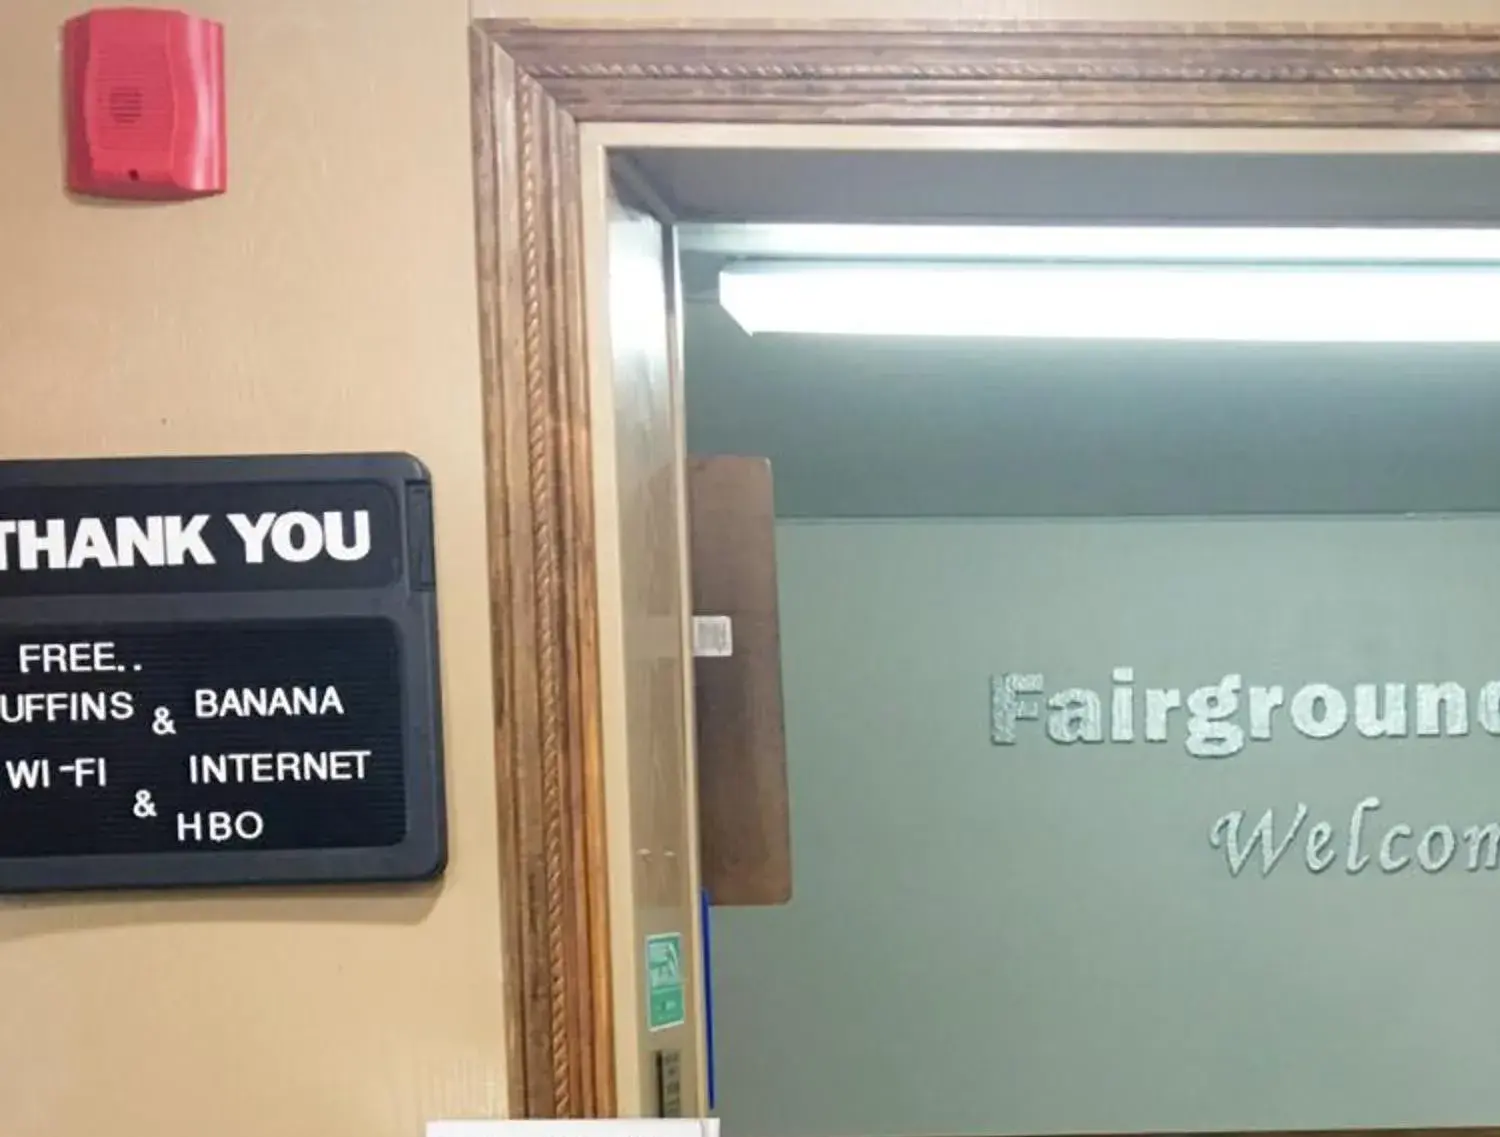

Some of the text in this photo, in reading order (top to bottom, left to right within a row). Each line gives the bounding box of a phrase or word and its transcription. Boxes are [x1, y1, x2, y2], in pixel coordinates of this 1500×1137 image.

[227, 510, 371, 564] YOU
[152, 707, 177, 735] &
[195, 686, 345, 719] BANANA
[189, 751, 372, 784] INTERNET
[133, 790, 157, 818] &
[177, 812, 264, 842] HBO
